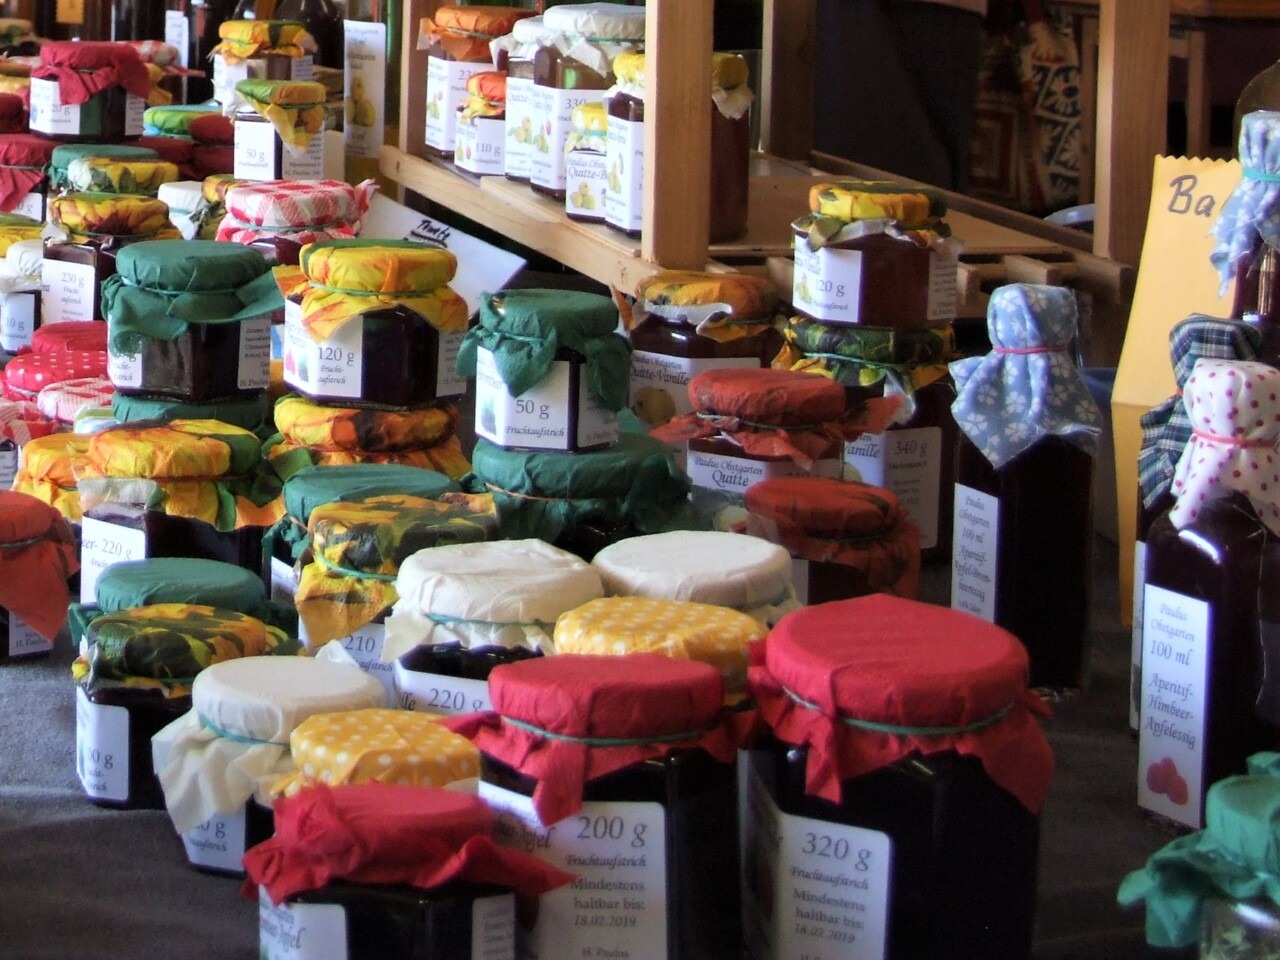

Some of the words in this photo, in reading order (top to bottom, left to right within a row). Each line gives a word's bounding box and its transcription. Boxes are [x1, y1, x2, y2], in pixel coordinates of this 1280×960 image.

[493, 145, 501, 156] g
[836, 284, 845, 298] g
[318, 346, 343, 362] 120
[347, 350, 355, 366] g
[515, 399, 535, 414] 50
[539, 404, 550, 420] g
[505, 426, 565, 438] Fruchtaufstrich
[694, 456, 719, 468] Paulus
[720, 458, 763, 475] Obstgarten
[712, 470, 750, 488] Quitte
[101, 538, 123, 556] 220
[1159, 602, 1188, 622] Paulus
[1150, 617, 1196, 643] Obstgarten
[344, 634, 375, 653] 210
[1150, 639, 1172, 660] 100
[1175, 648, 1193, 667] ml
[1148, 672, 1194, 702] Aperitif-
[428, 687, 465, 711] 220
[1148, 693, 1194, 722] Himbeer-
[1145, 715, 1196, 751] Apfelessig
[104, 755, 113, 769] g
[215, 821, 226, 839] g
[577, 815, 624, 840] 200
[631, 822, 648, 848] g
[565, 854, 646, 870] Fruchtaufstrich
[802, 832, 850, 860] 320
[854, 848, 872, 872] g
[571, 878, 646, 891] Mindestens
[789, 865, 869, 891] Fruchtaufstrich
[574, 897, 619, 910] haltbar
[623, 897, 645, 910] bis:
[793, 888, 866, 913] Mindestens
[574, 914, 637, 927] 18.02.2019
[795, 907, 840, 927] haltbar
[842, 914, 865, 930] bis:
